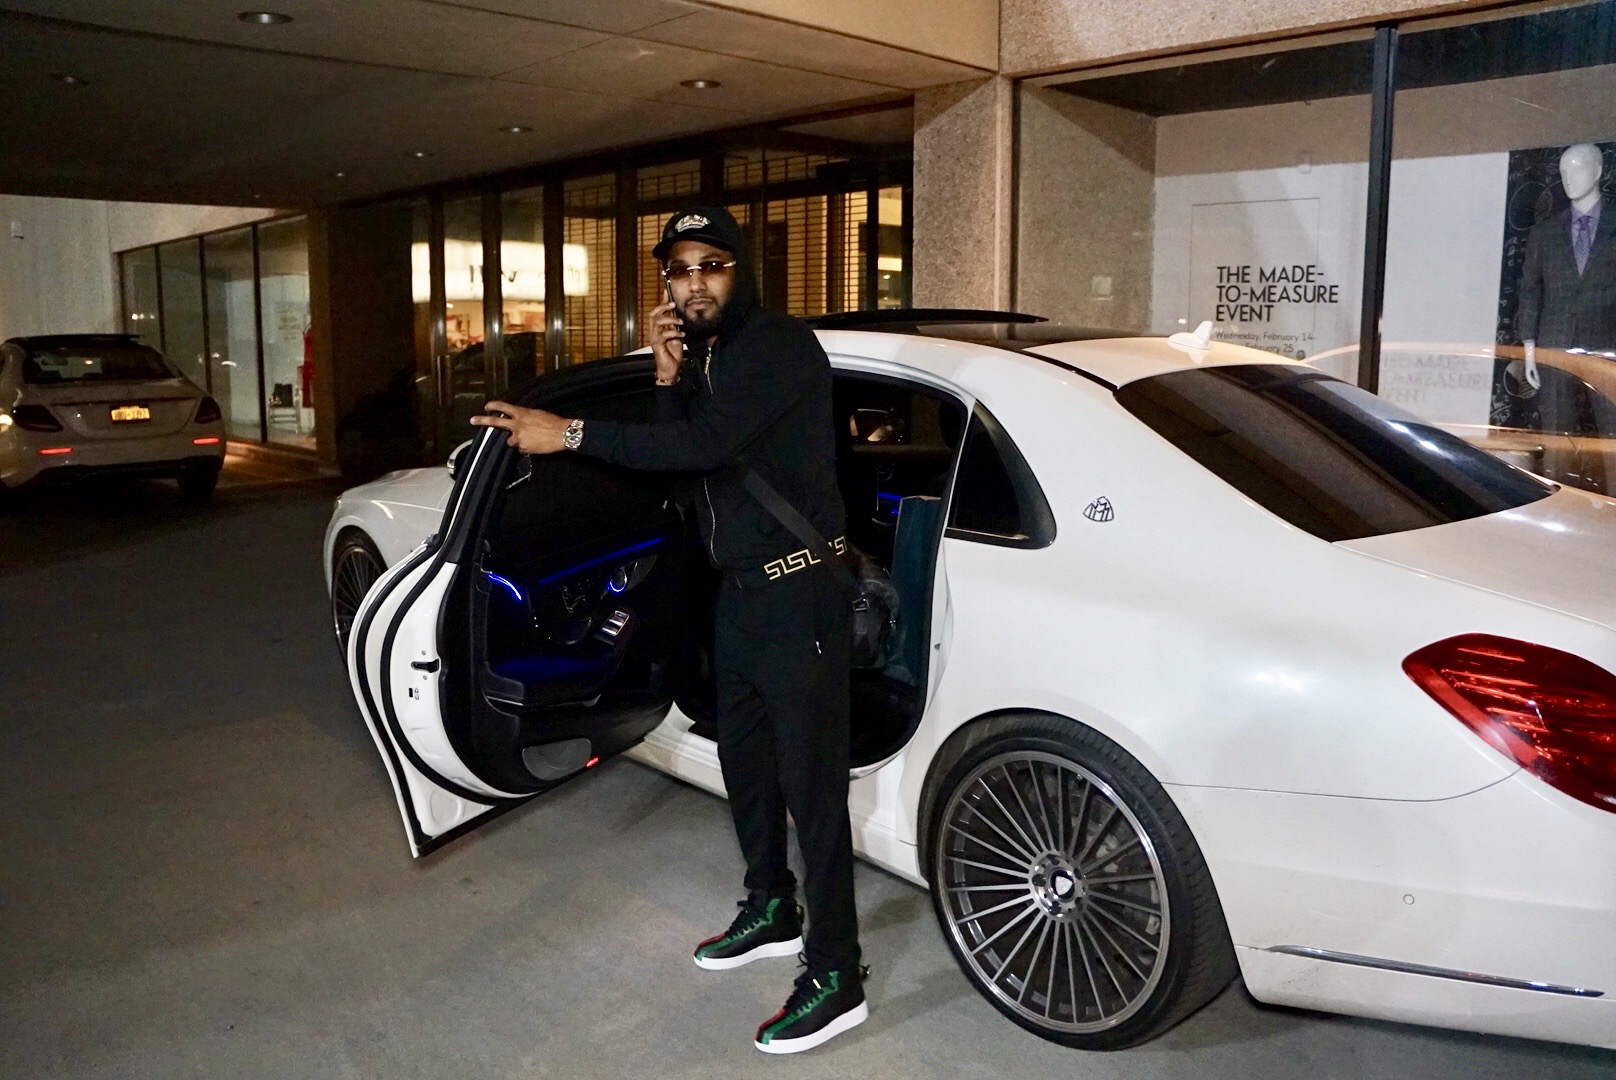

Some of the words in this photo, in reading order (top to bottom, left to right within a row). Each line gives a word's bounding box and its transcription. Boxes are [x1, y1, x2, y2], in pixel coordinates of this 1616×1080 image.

[1216, 266, 1251, 283] THE
[1259, 265, 1324, 283] MADE-
[1216, 285, 1339, 303] TO-MEASURE
[1216, 305, 1274, 322] EVENT
[1263, 332, 1299, 342] February
[1283, 343, 1294, 353] 25
